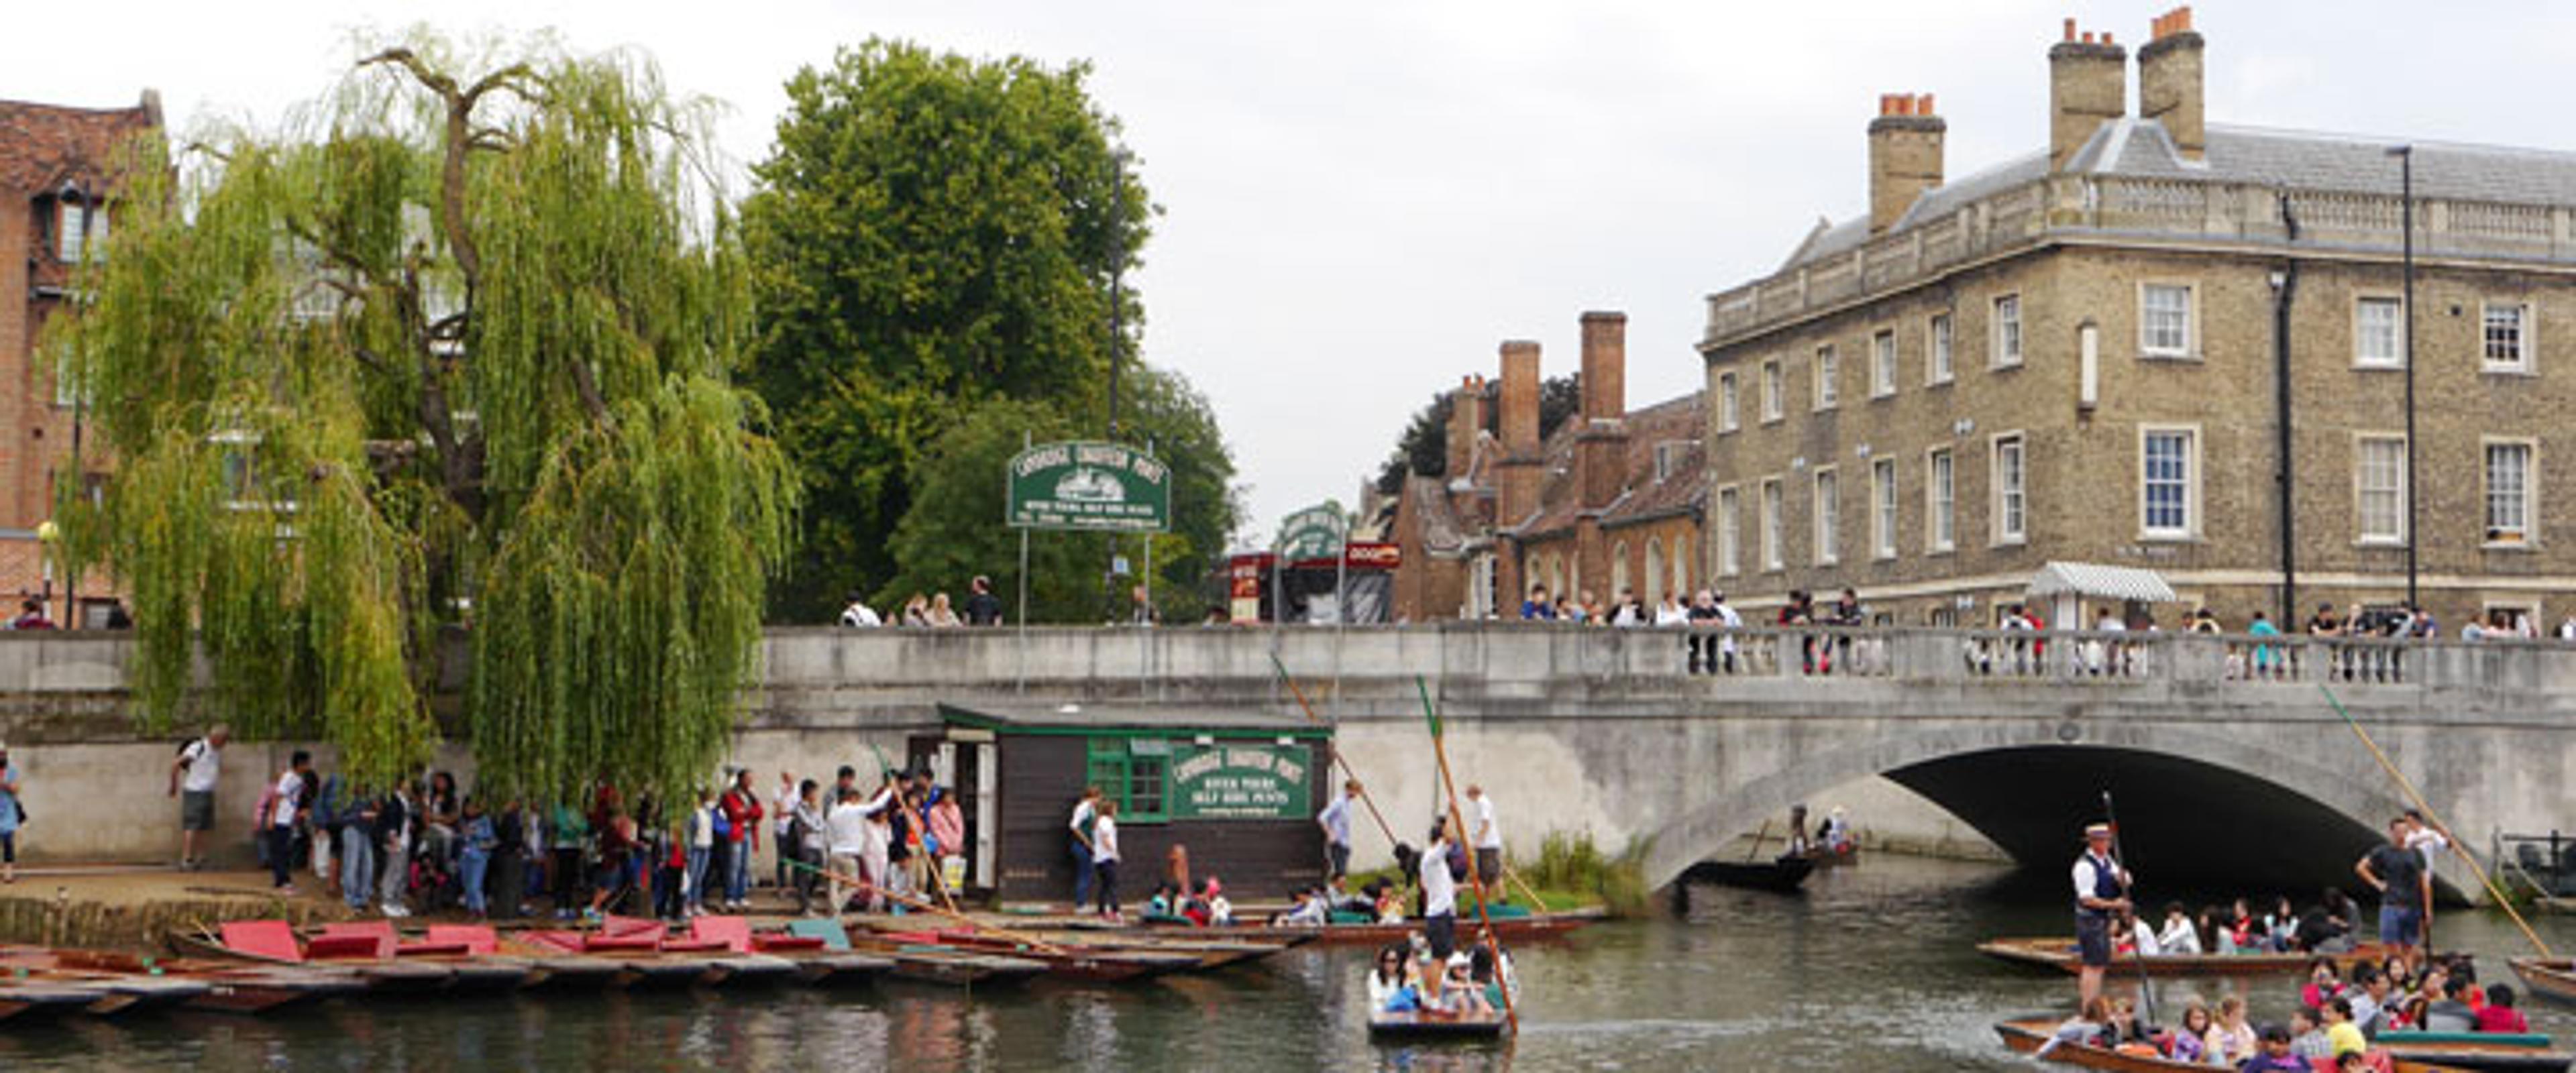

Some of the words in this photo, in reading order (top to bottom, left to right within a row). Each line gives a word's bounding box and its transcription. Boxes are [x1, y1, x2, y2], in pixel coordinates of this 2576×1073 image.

[1205, 777, 1238, 789] RIVER
[1191, 791, 1218, 803] SELF
[1252, 791, 1289, 804] PUNTS
